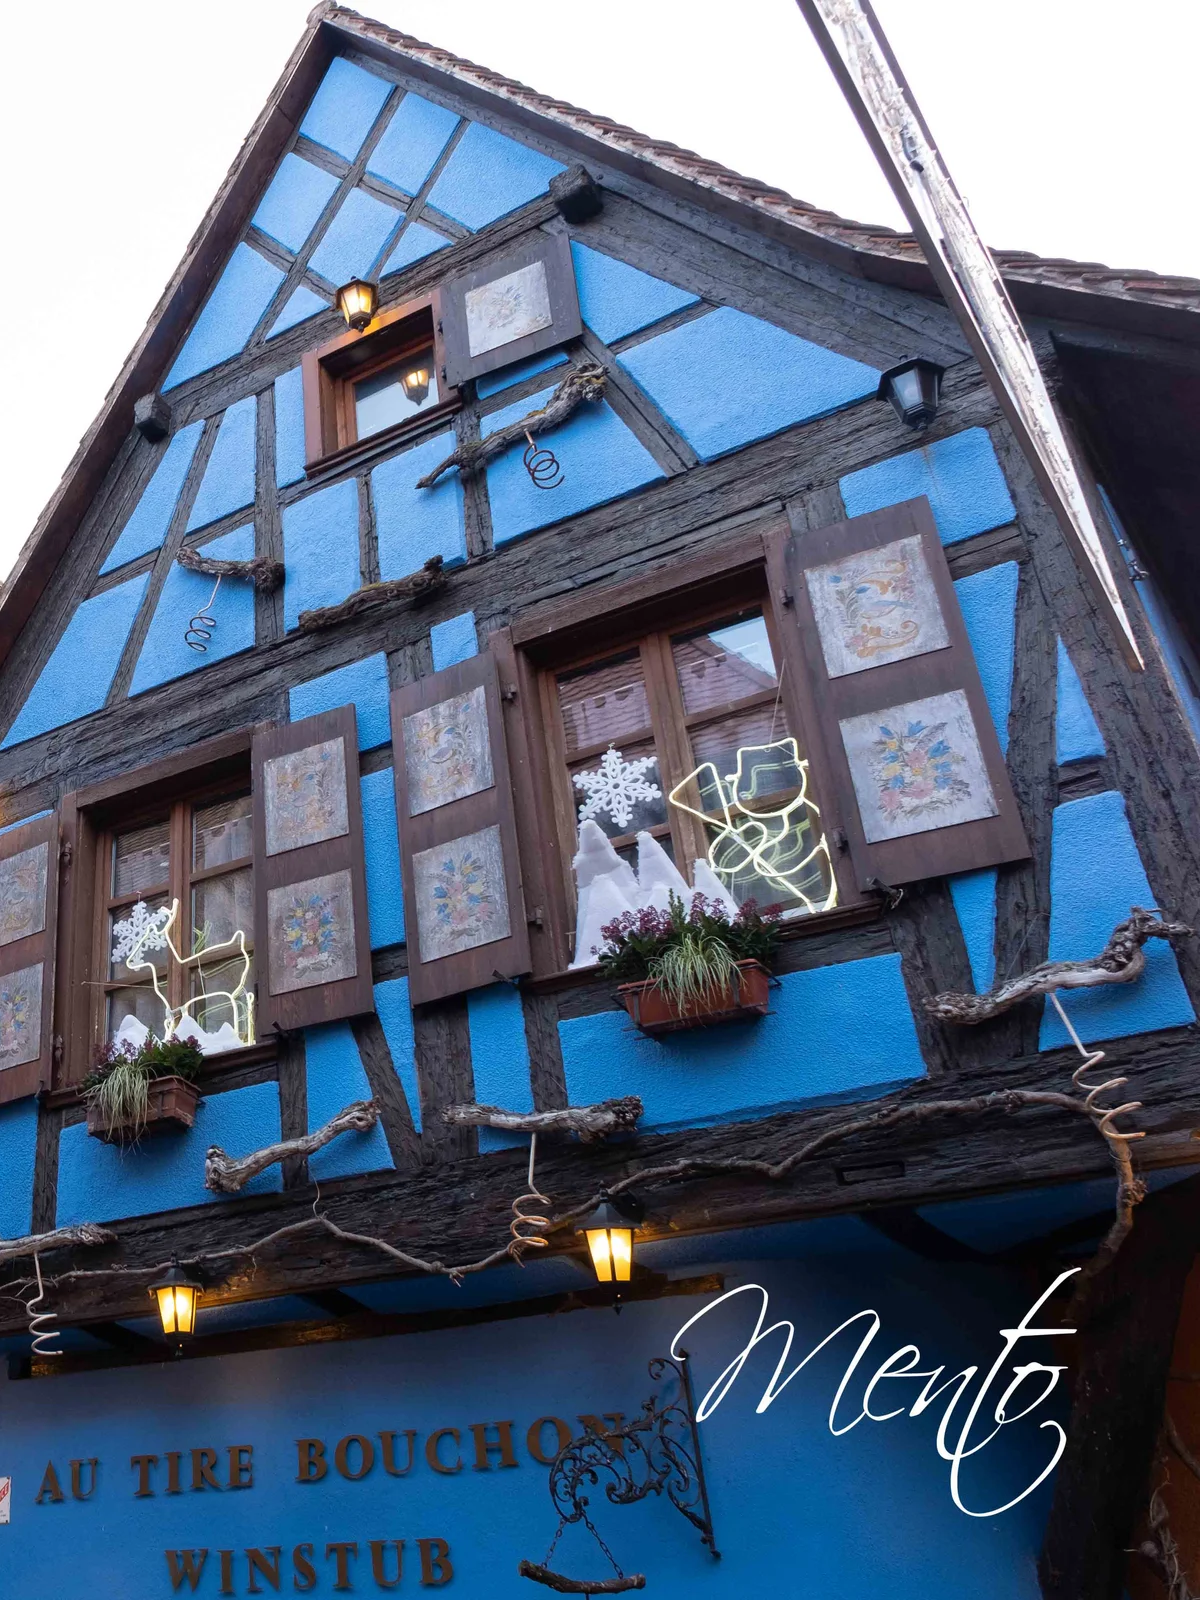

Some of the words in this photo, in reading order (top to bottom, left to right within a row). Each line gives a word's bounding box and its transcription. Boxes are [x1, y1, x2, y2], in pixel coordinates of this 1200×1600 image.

[35, 1457, 98, 1503] AU
[130, 1444, 254, 1498] TIRE
[294, 1411, 626, 1483] BOUCHON
[164, 1537, 453, 1594] WINSTUB
